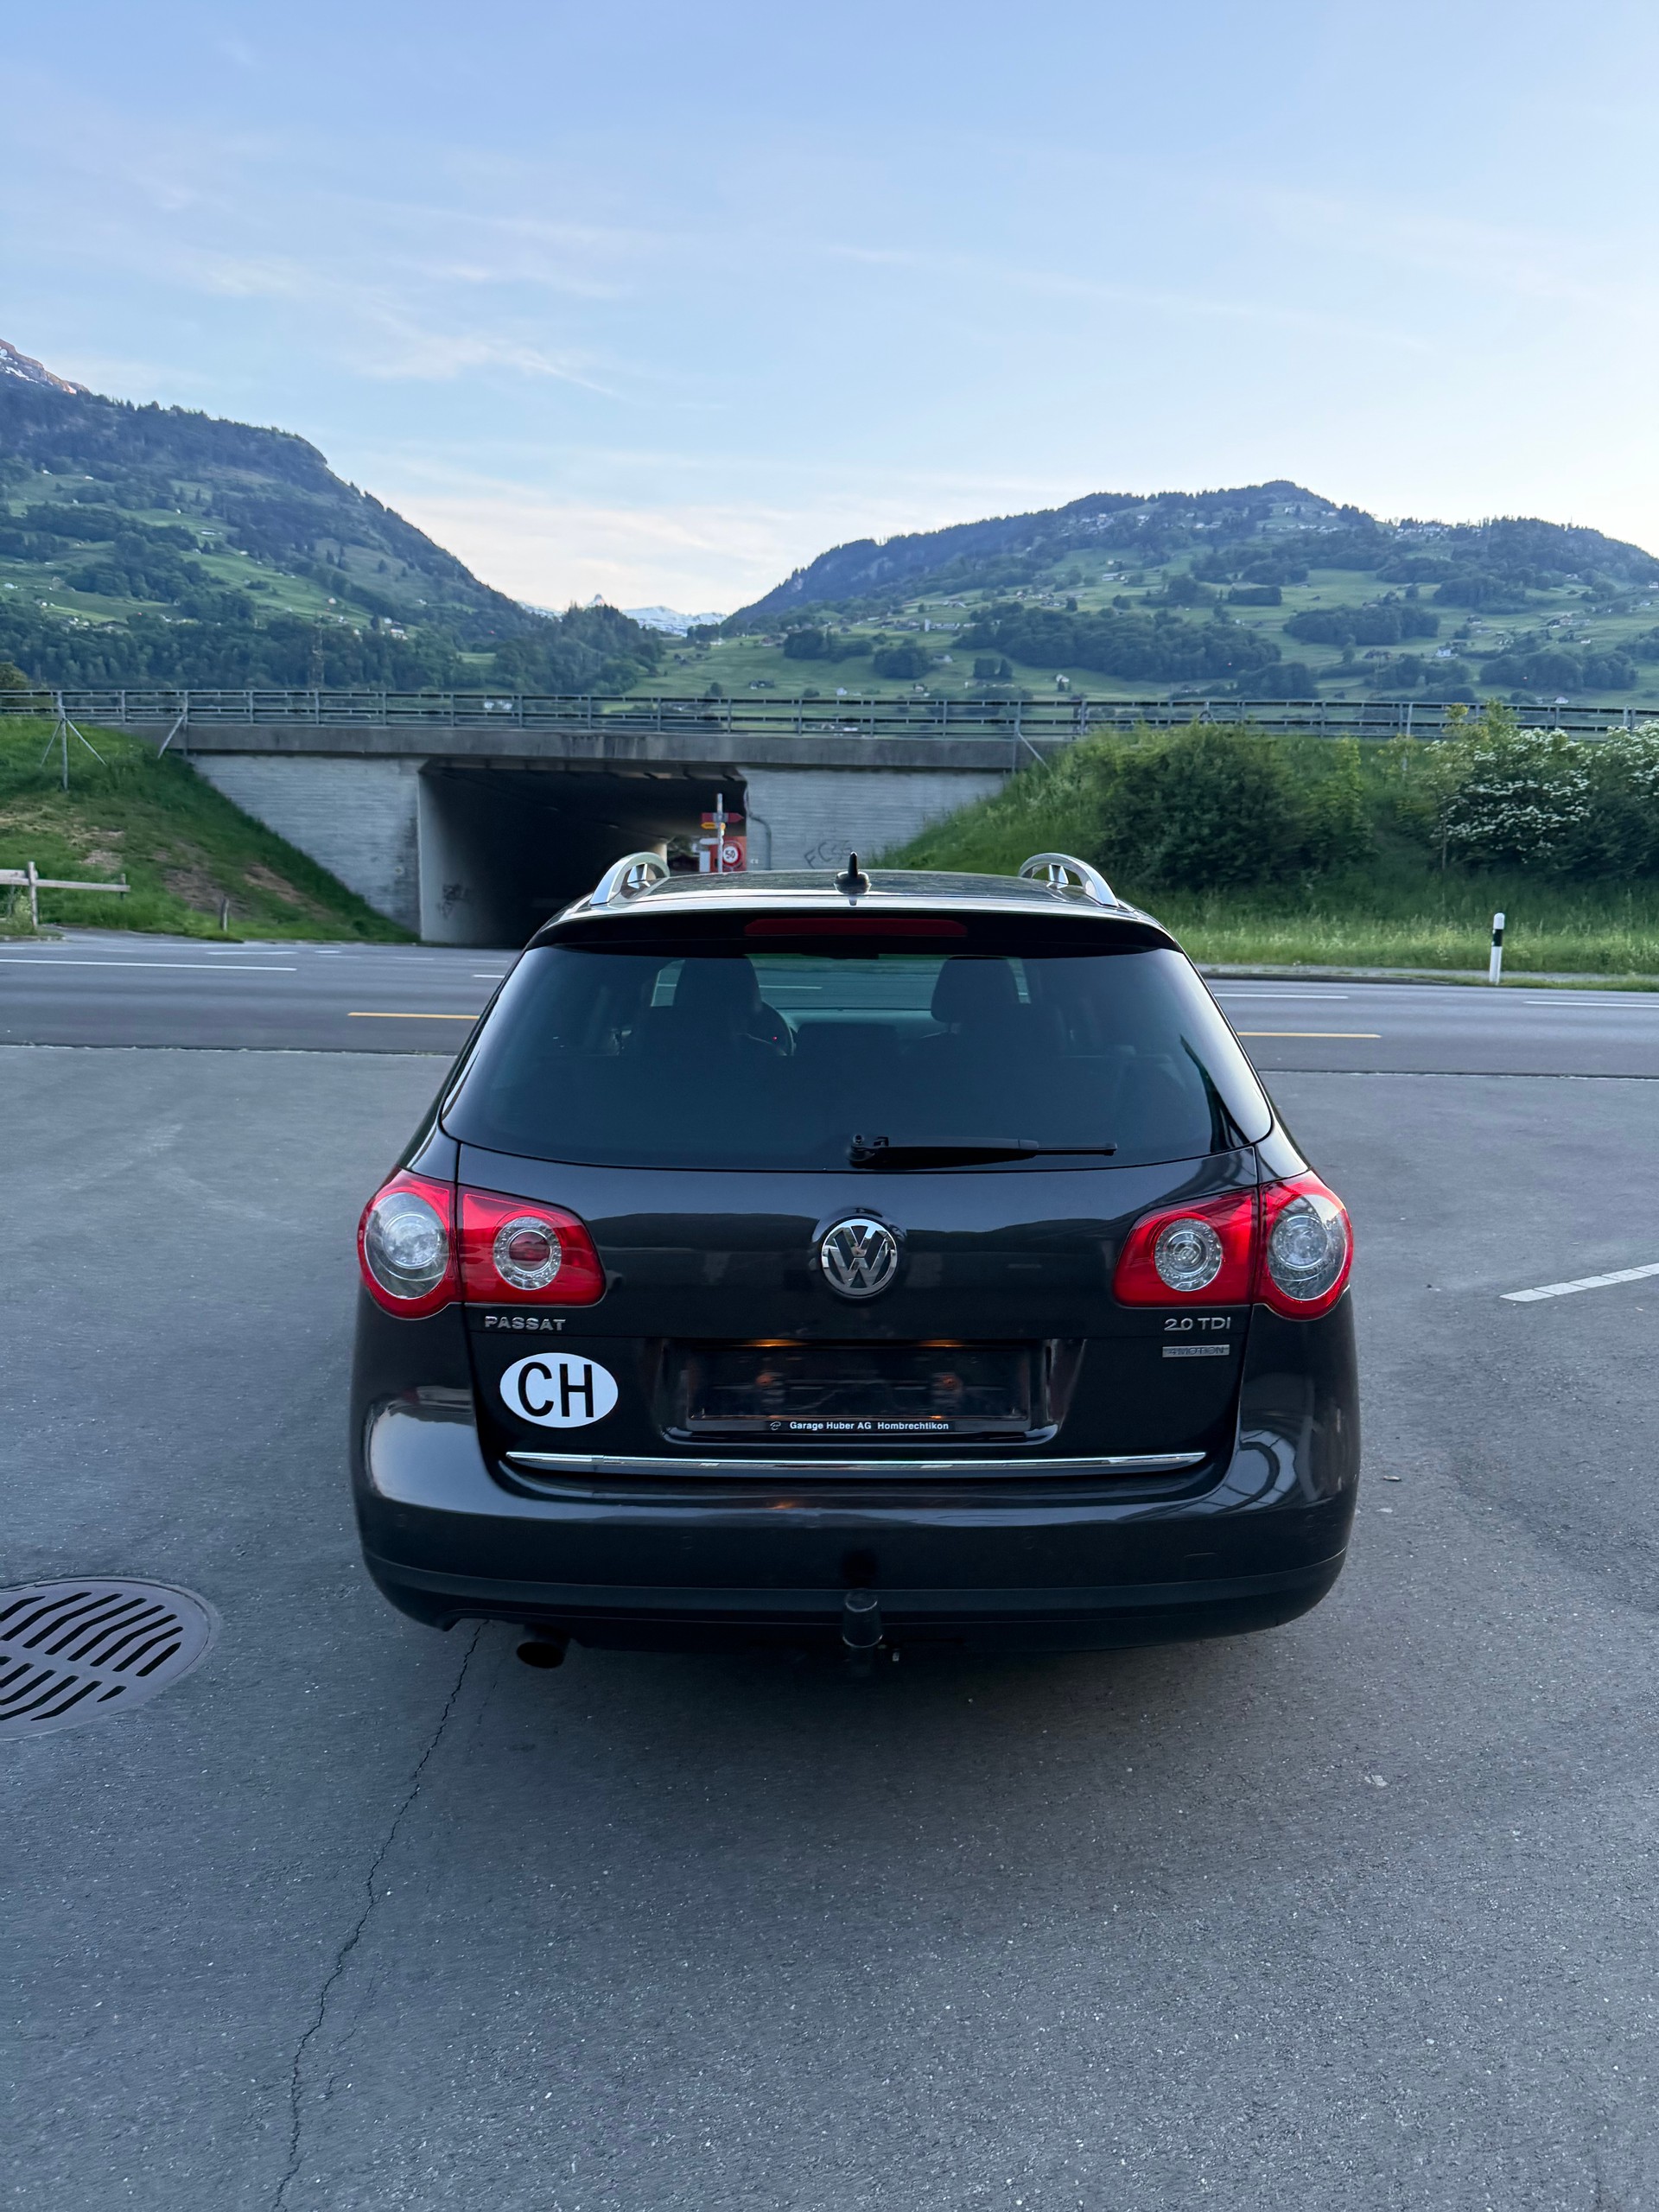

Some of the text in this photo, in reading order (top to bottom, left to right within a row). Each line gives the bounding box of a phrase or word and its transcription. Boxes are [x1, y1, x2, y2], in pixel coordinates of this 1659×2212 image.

[725, 849, 736, 860] 50
[821, 1218, 898, 1296] VW
[484, 1315, 567, 1332] PASSAT
[1197, 1316, 1230, 1330] TDI
[518, 1362, 594, 1418] CH
[790, 1421, 949, 1431] Garage Huber AG Hombrechtikon
